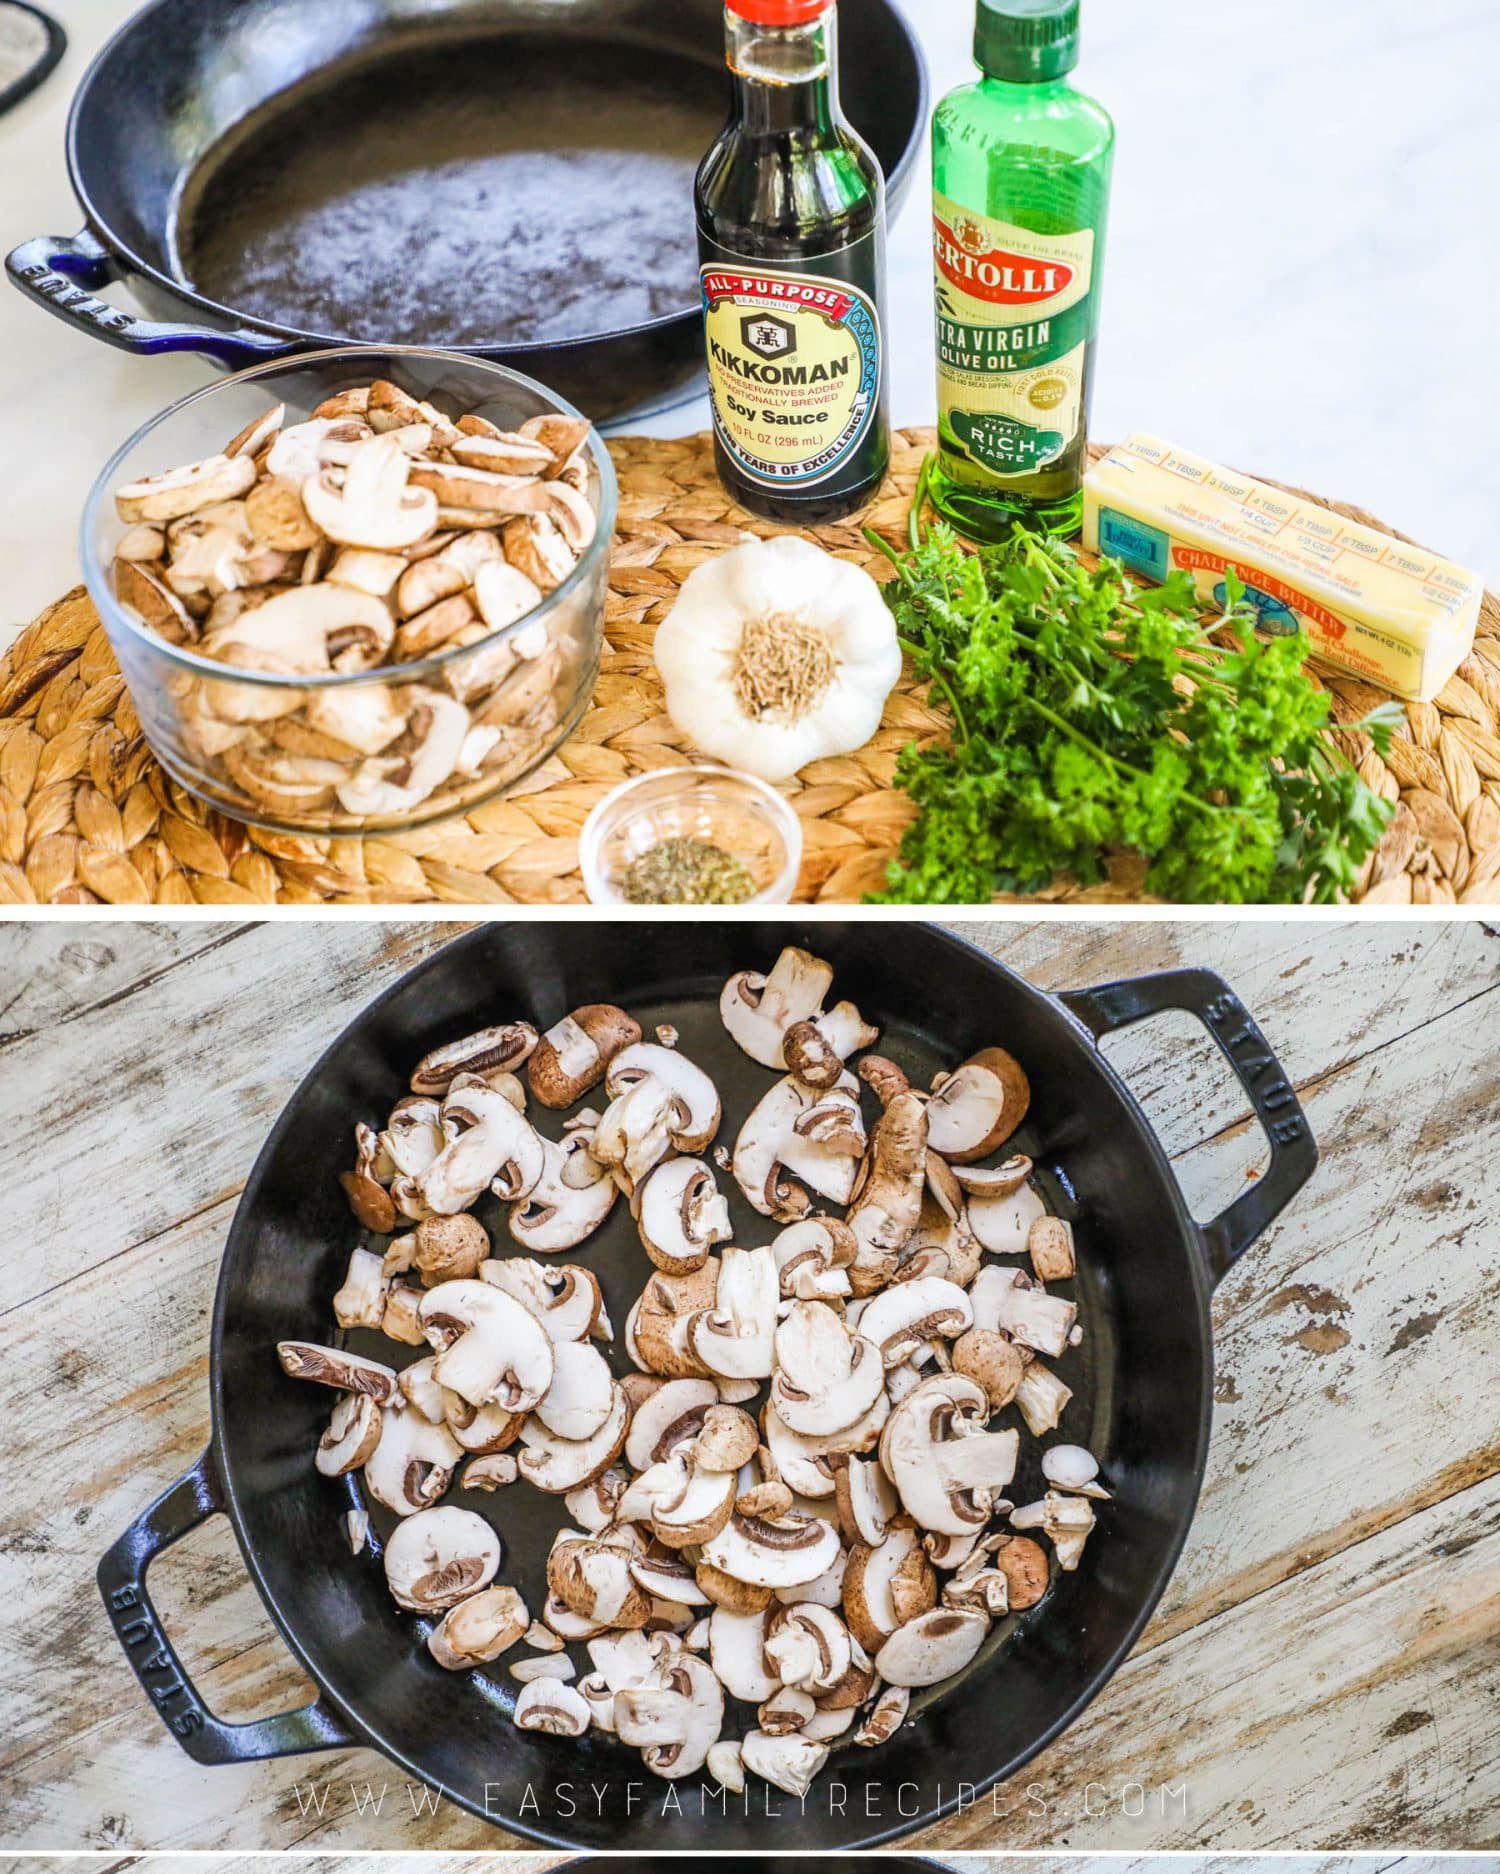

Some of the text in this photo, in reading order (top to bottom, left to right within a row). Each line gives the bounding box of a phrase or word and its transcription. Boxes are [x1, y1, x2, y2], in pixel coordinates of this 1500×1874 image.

[21, 264, 137, 331] STAUB
[736, 296, 798, 311] SEASONING
[973, 321, 1050, 352] VIRGIN
[710, 336, 849, 386] KIKKOMAN
[941, 346, 1017, 369] OLIVE OIL
[720, 376, 788, 407] TRADITIONALLY
[792, 392, 839, 407] BREWED
[726, 373, 805, 397] PRESERVATIVES
[808, 380, 844, 395] ADDED
[726, 394, 757, 422] Soy
[762, 409, 829, 425] Sauce
[739, 447, 777, 475] YEARS
[781, 465, 799, 476] OF
[802, 408, 865, 473] EXCELLENCE
[744, 428, 755, 442] FL
[757, 432, 772, 446] OZ
[774, 435, 799, 449] (296
[971, 426, 1035, 454] RICH
[978, 444, 1025, 463] TASTE
[1176, 462, 1202, 479] TBSP
[1177, 549, 1272, 592] CHALLNGE
[1279, 584, 1340, 637] BUTTER
[1308, 628, 1330, 645] Real
[1324, 646, 1346, 663] Real
[1204, 993, 1301, 1145] STAUB
[111, 1582, 202, 1737] STAUB
